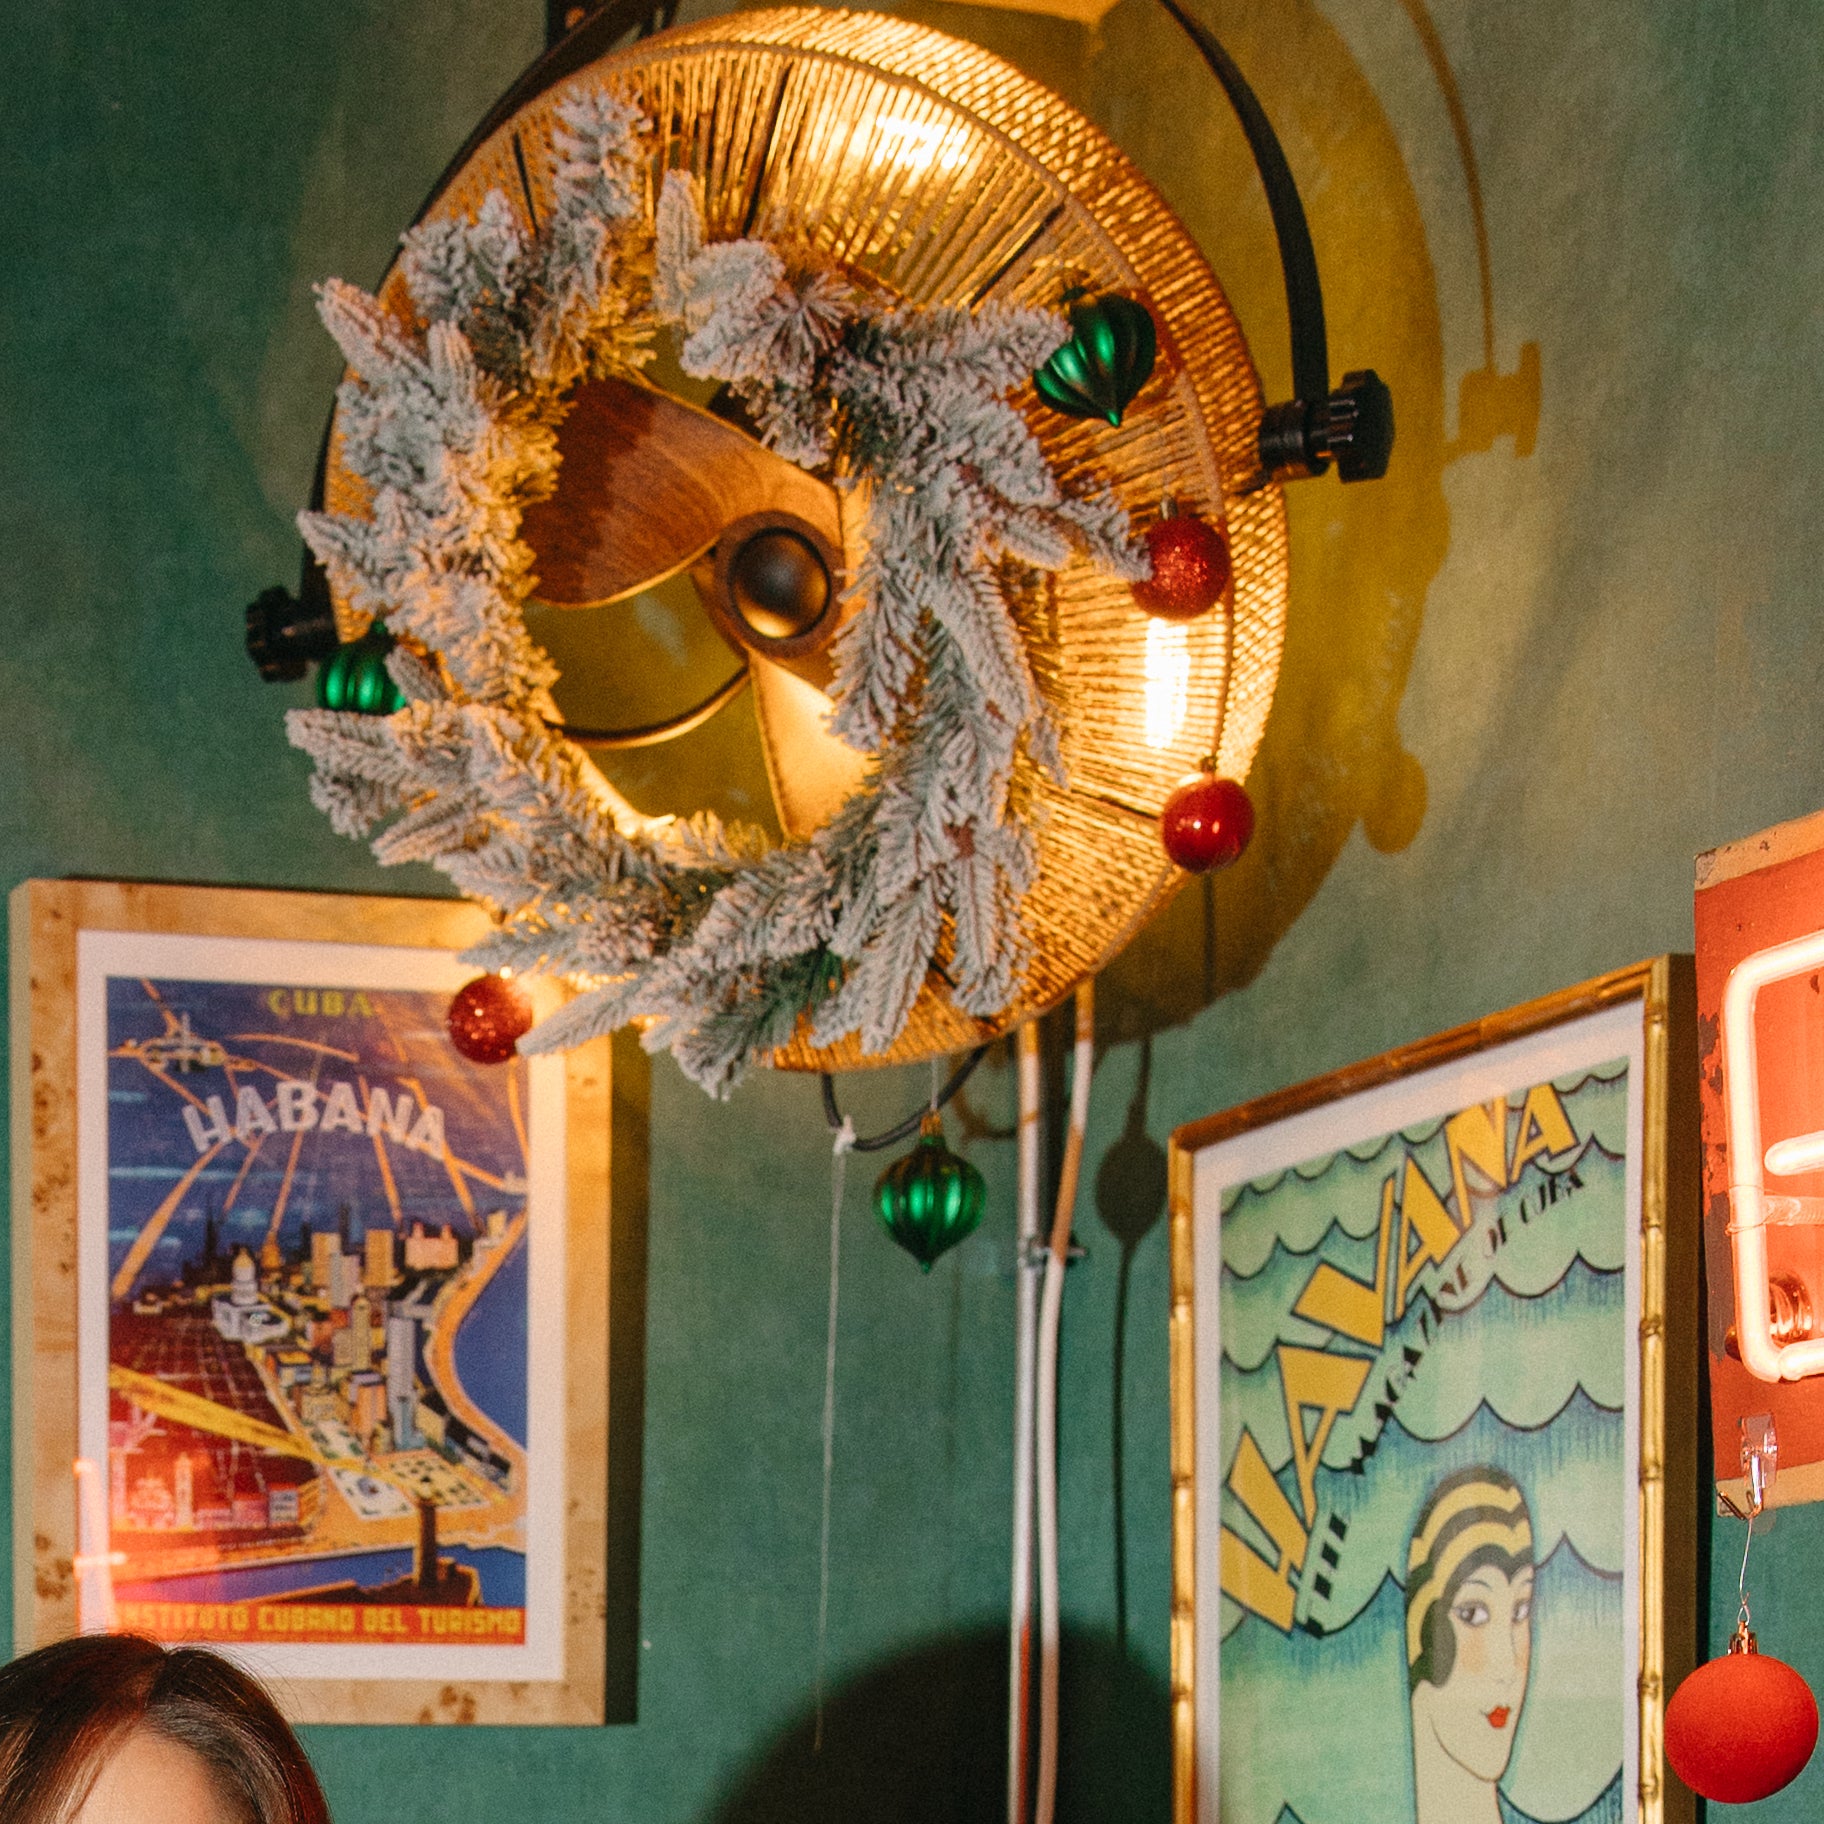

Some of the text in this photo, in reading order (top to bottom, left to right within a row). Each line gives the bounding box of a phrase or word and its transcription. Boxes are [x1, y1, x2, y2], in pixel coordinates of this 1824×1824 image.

[266, 988, 374, 1019] CUBA
[181, 1079, 449, 1162] HABANA
[1220, 1082, 1578, 1634] HAVANA
[258, 1605, 355, 1633] CUBANO
[363, 1607, 408, 1633] DEL
[416, 1608, 521, 1635] TURISMO
